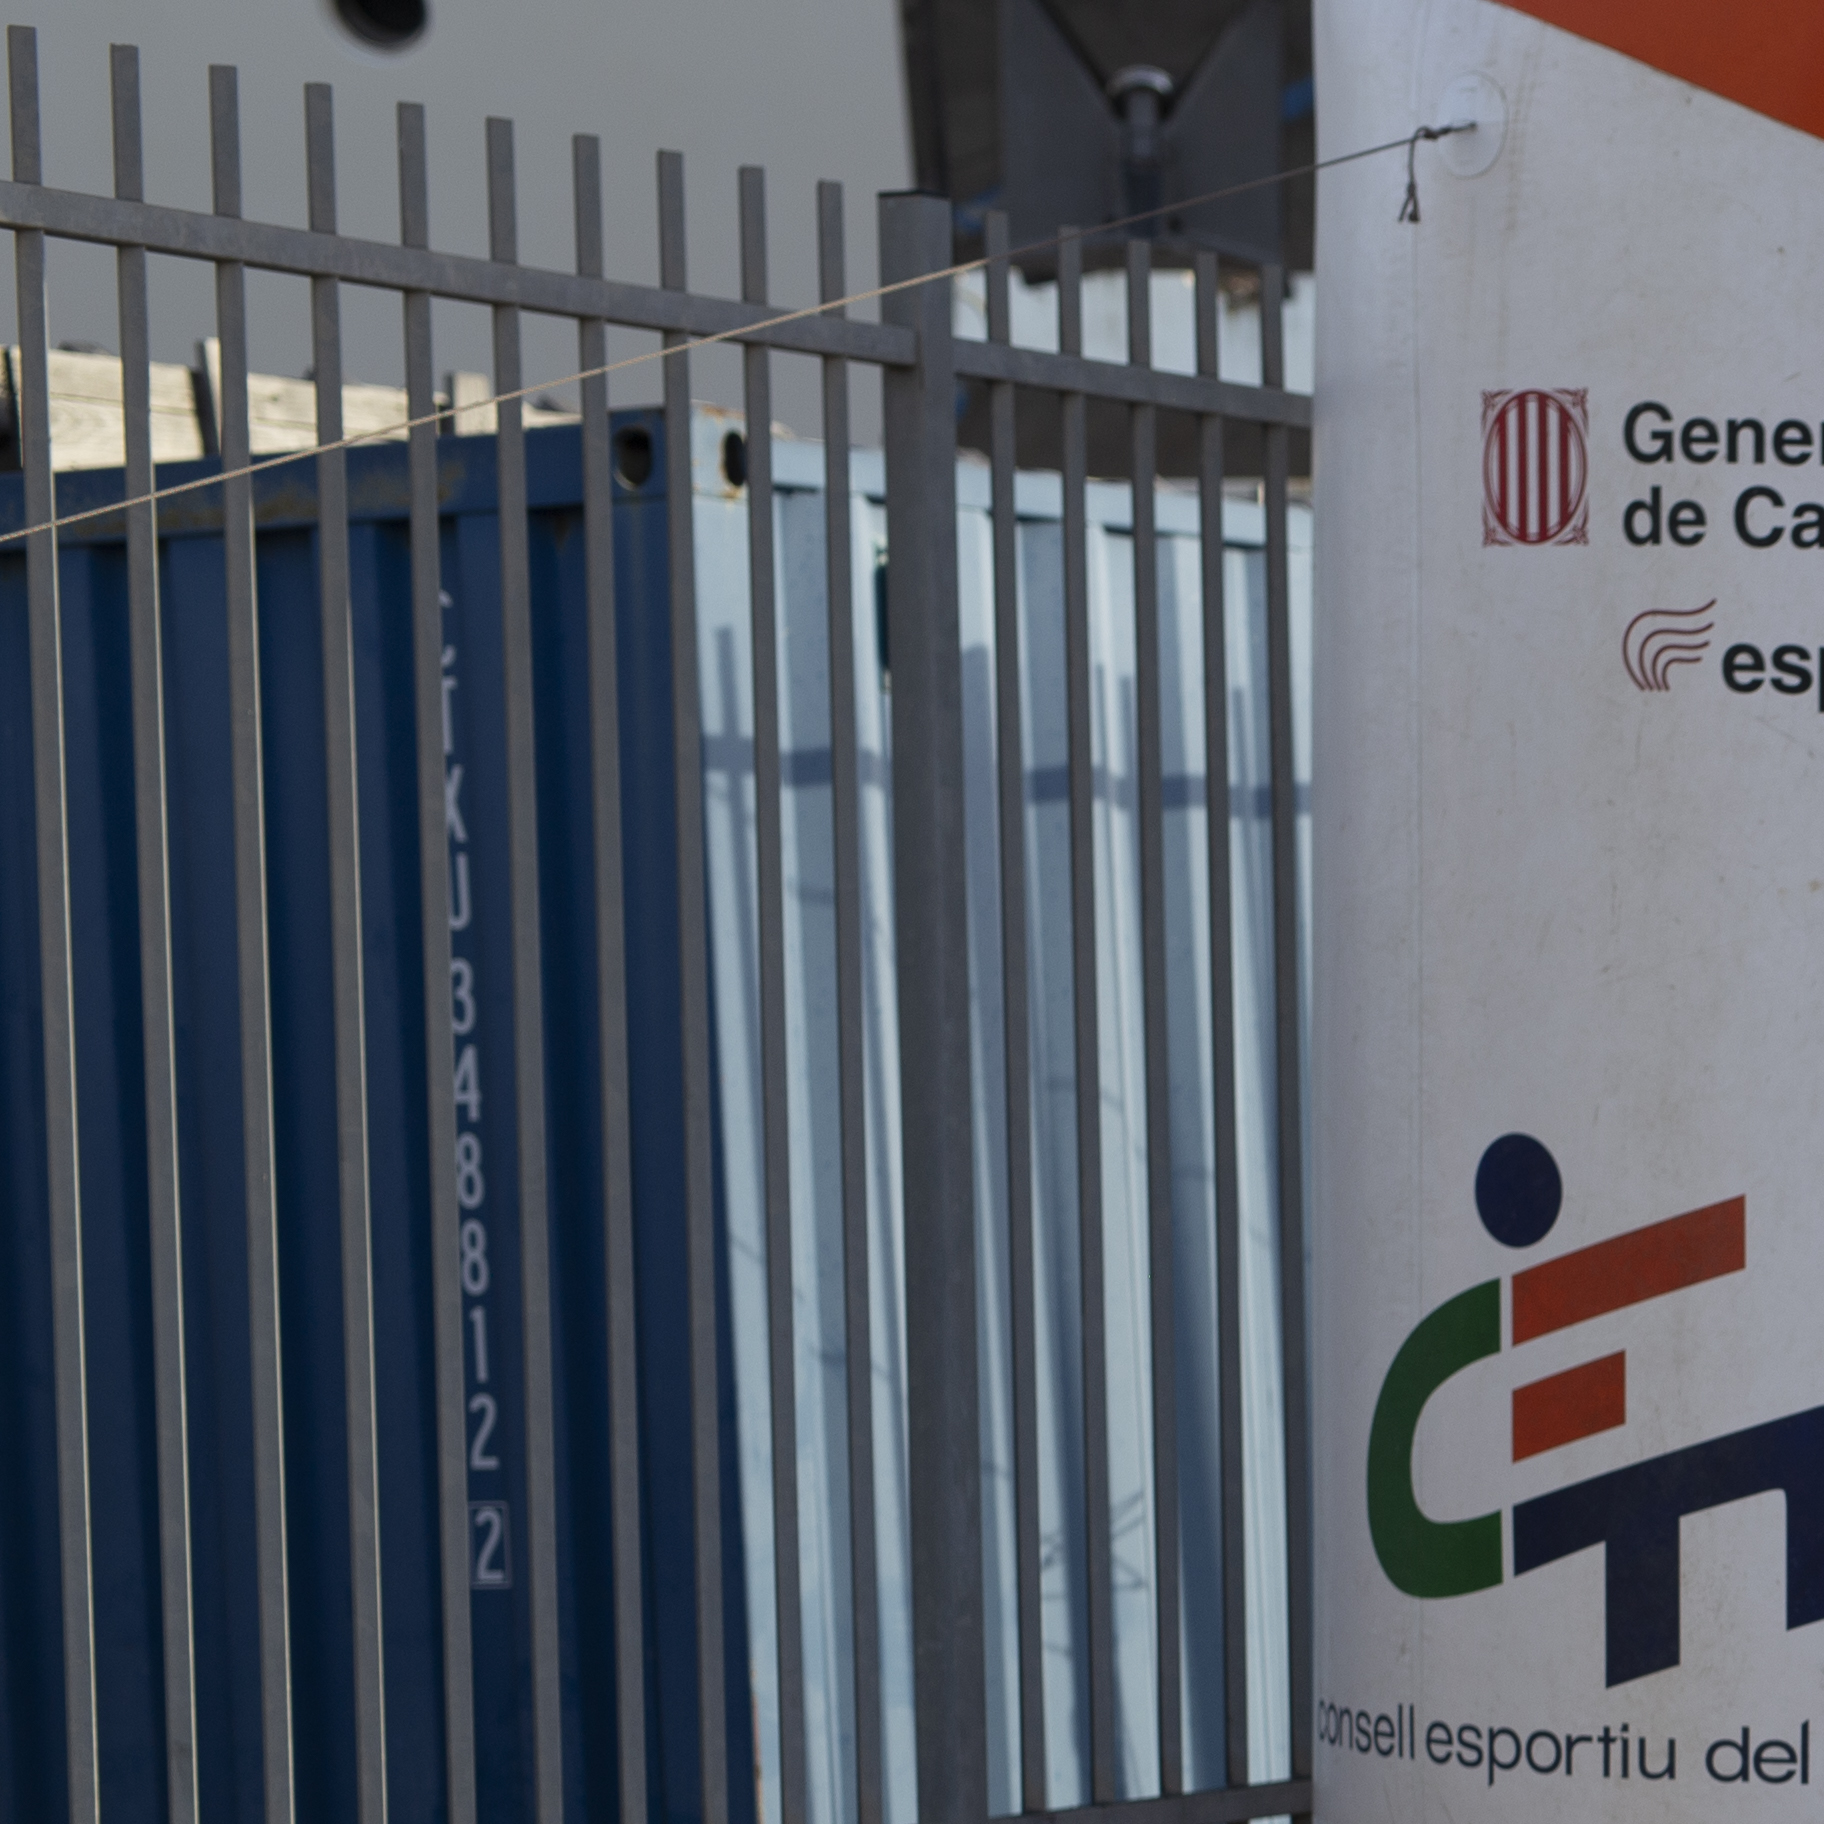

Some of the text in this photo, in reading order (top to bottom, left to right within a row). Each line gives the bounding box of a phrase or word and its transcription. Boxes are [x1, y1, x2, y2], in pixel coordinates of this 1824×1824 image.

[1622, 486, 1708, 546] de
[1316, 1698, 1415, 1760] consell
[1425, 1720, 1677, 1788] esportiu
[1704, 1719, 1810, 1785] del
